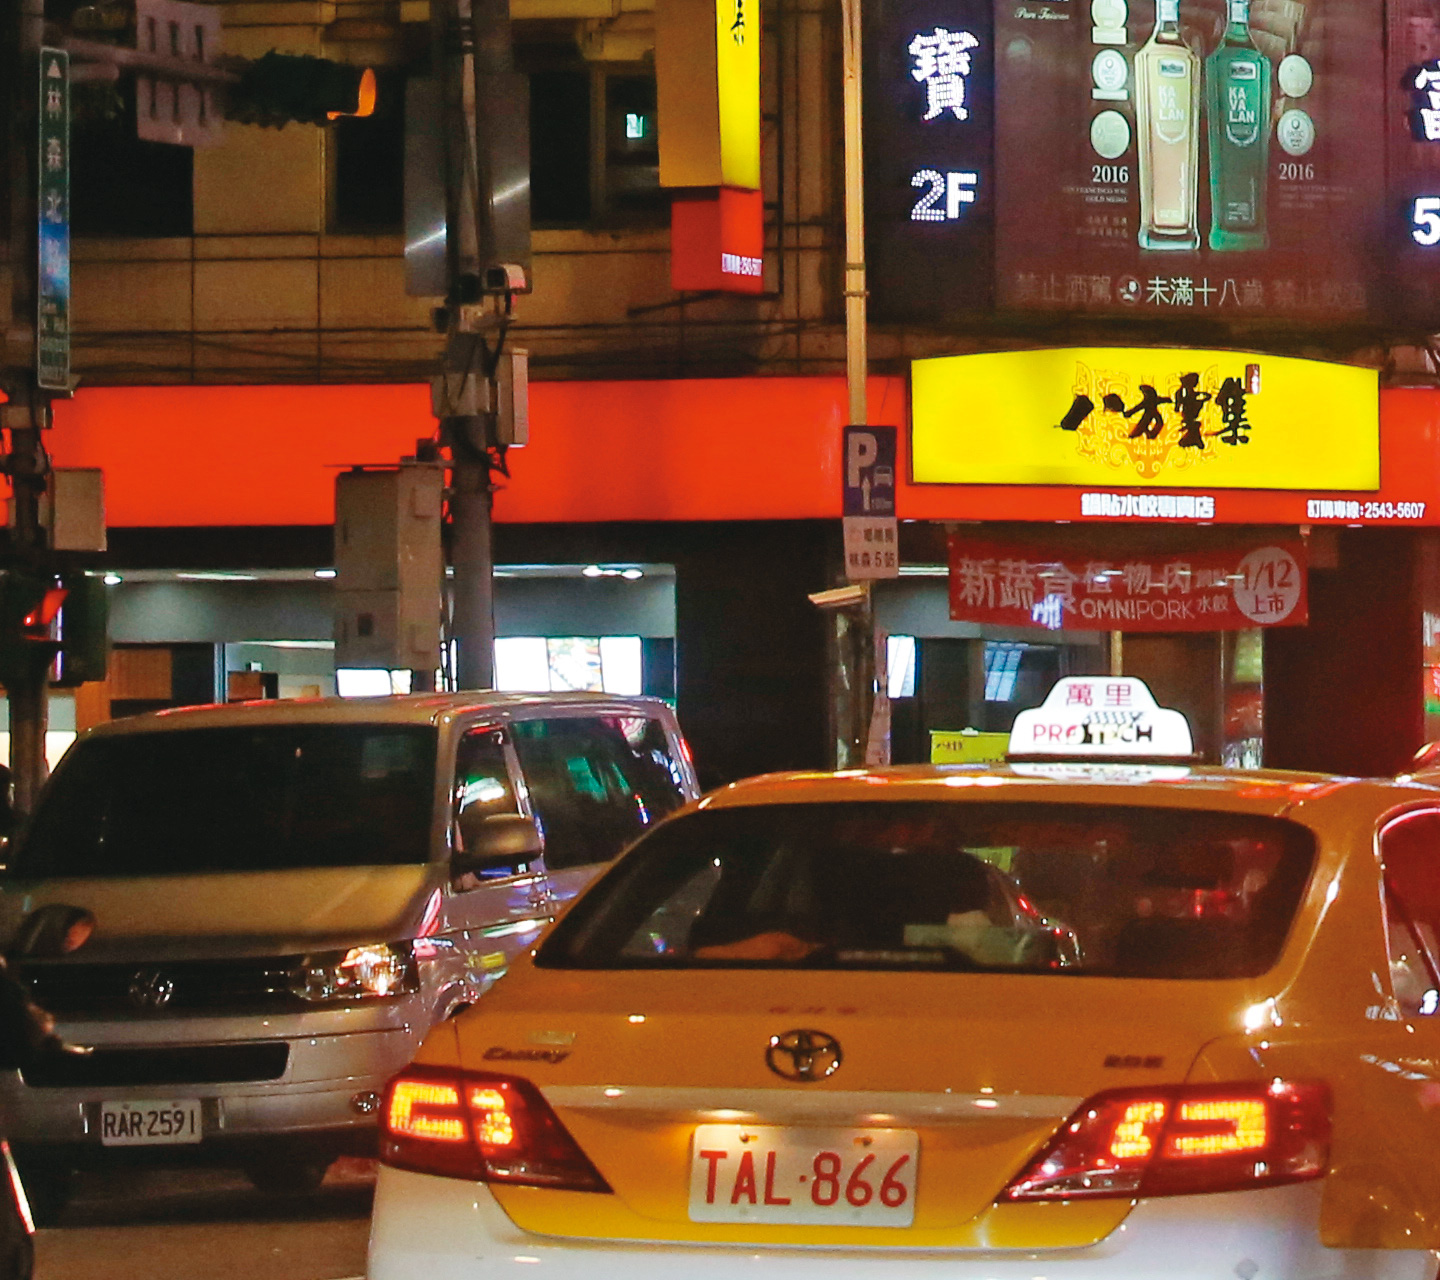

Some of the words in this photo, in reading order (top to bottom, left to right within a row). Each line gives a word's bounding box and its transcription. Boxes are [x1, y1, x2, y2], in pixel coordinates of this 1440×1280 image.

[1229, 109, 1255, 124] LAN
[1092, 165, 1129, 184] 2016
[1278, 162, 1314, 181] 2016
[910, 170, 978, 222] 2F
[1053, 371, 1252, 451] 八方雲集
[848, 432, 878, 488] P
